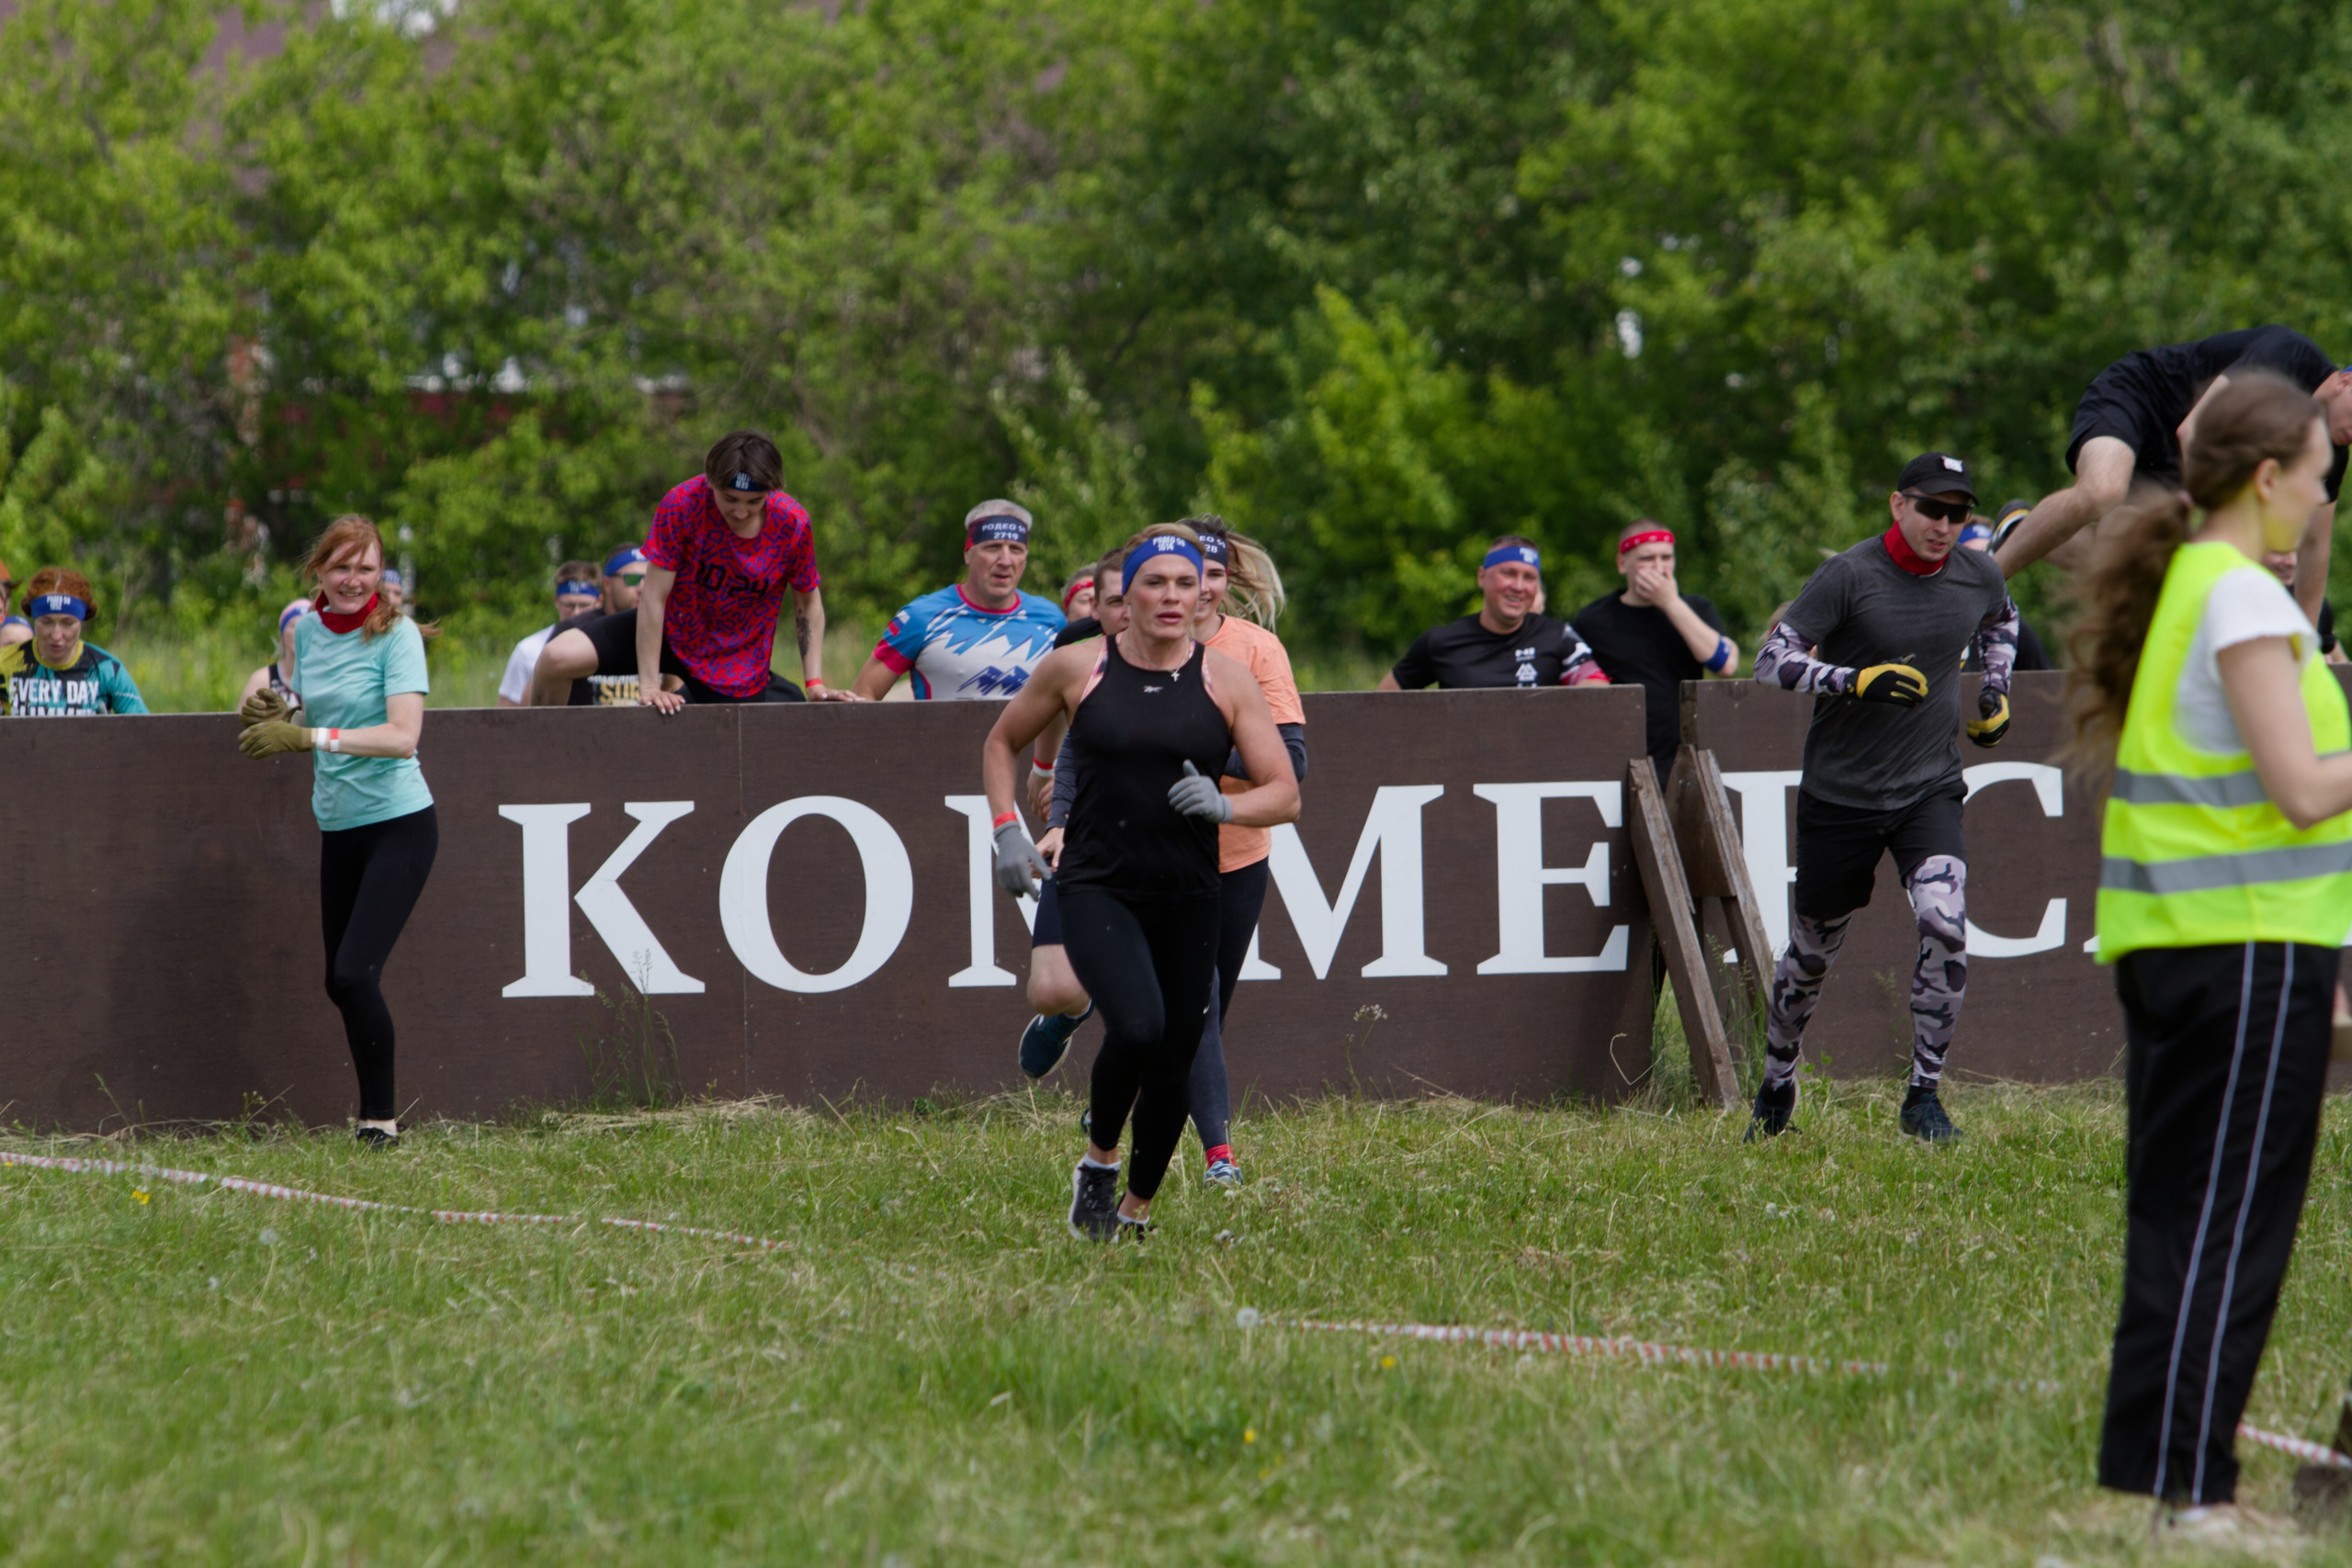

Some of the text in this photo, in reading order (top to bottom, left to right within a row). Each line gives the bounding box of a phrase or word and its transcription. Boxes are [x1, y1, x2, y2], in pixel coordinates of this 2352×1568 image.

[982, 523, 1017, 532] РОДЕО
[993, 532, 1019, 540] 2719
[9, 677, 99, 705] EVERY DAY
